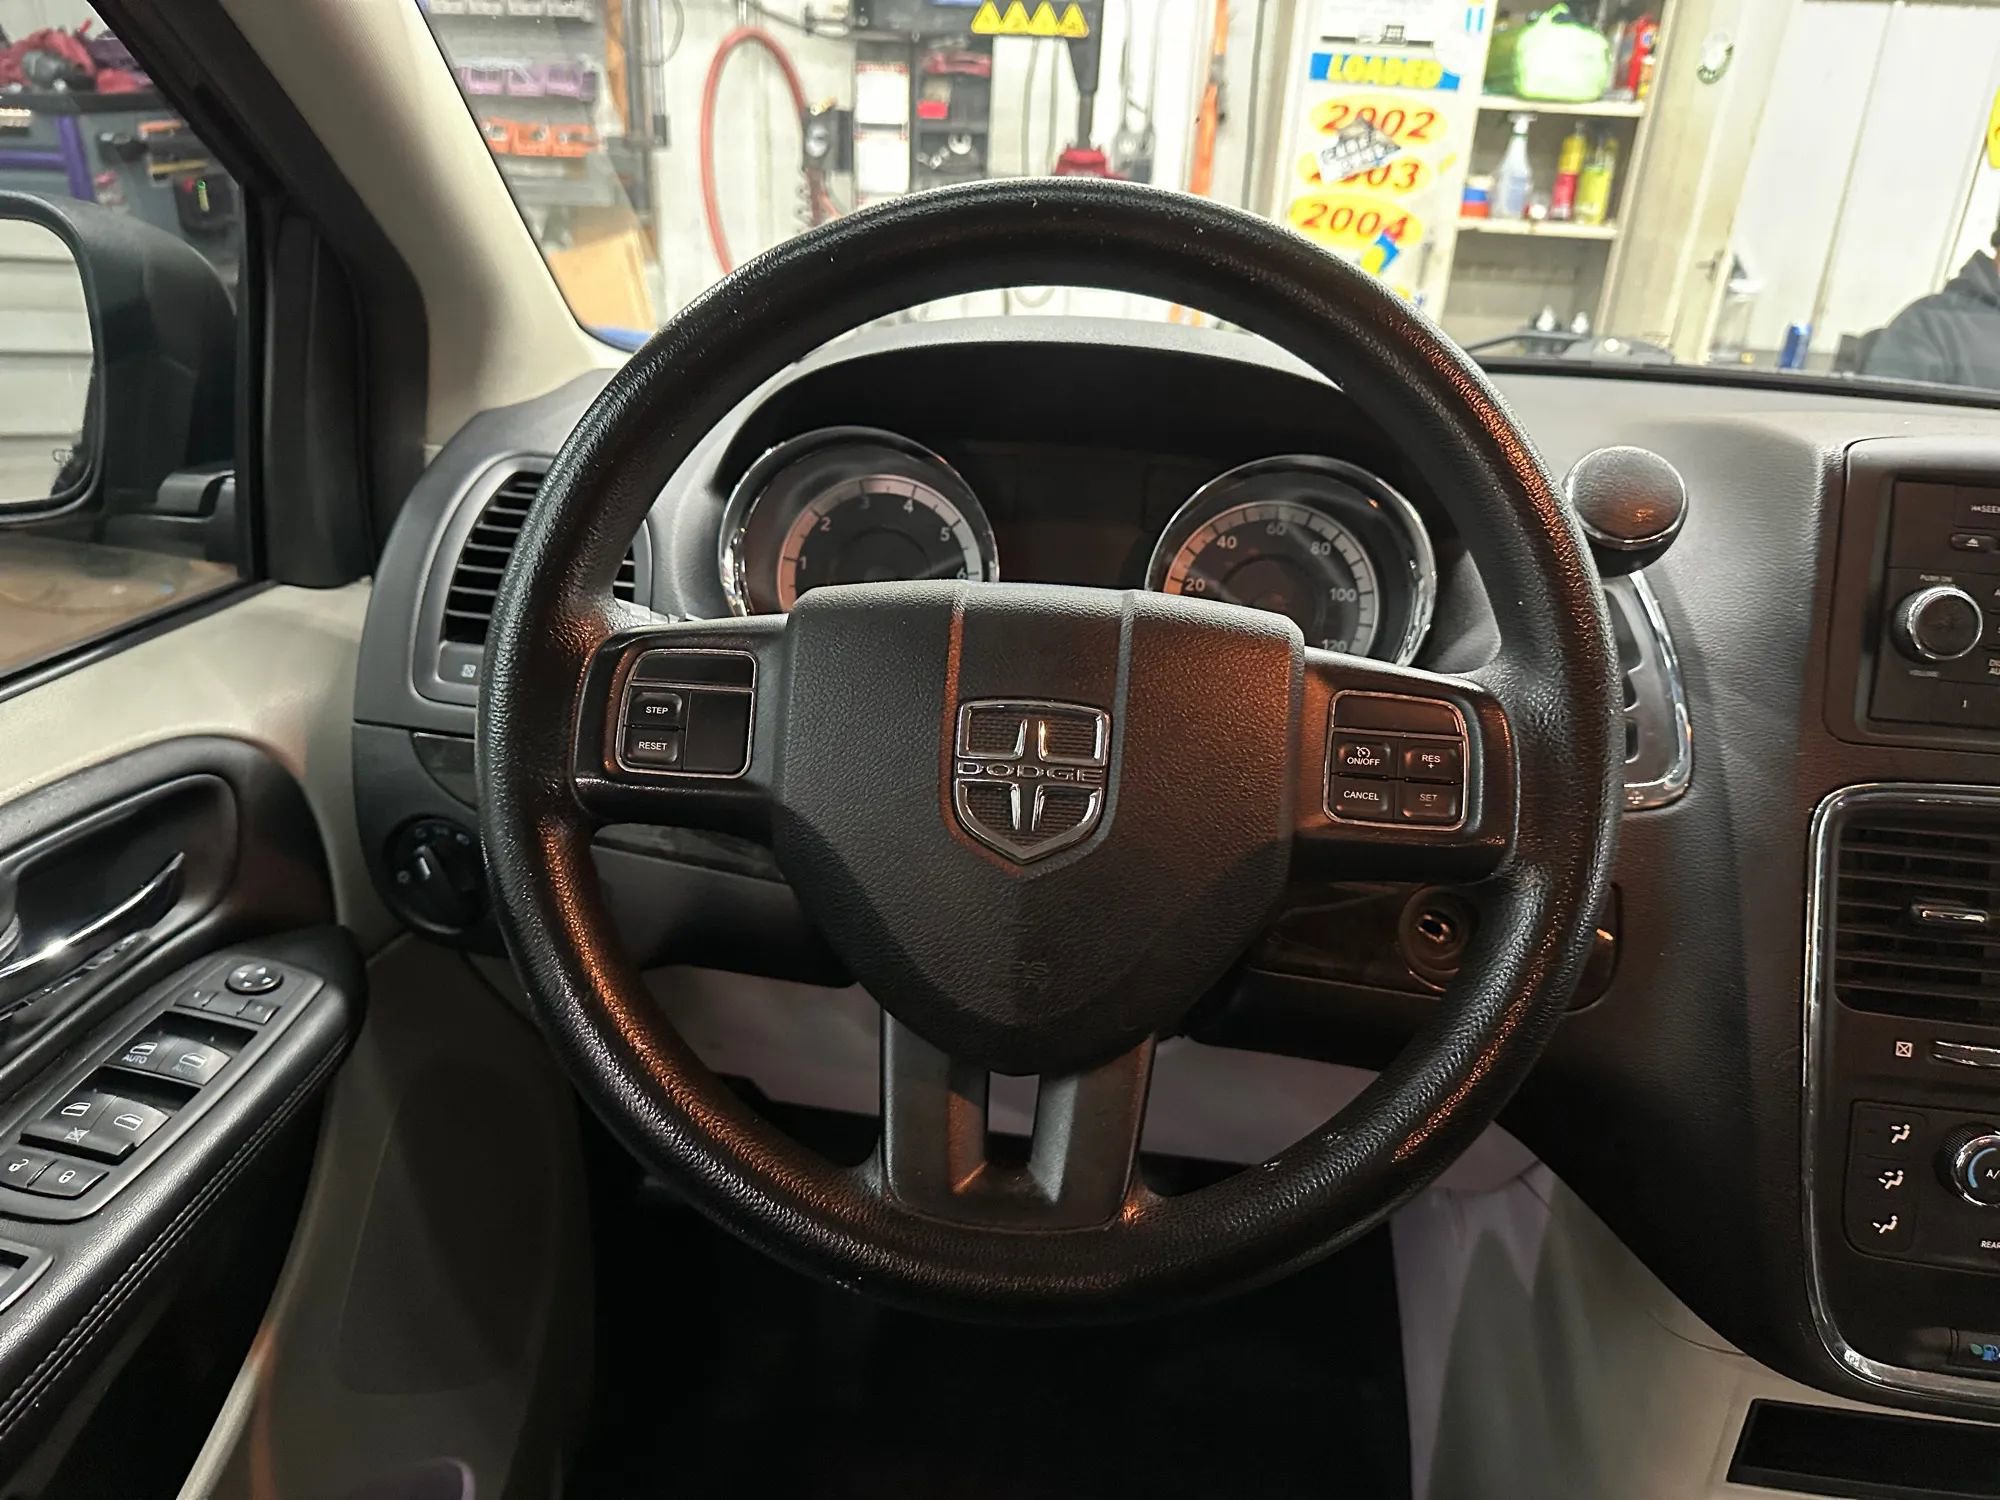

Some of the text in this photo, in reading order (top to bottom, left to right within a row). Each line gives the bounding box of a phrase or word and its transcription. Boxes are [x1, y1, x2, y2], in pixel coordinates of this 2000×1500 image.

[1326, 54, 1444, 89] LOADED
[1302, 203, 1409, 241] 2004
[903, 499, 914, 513] 4
[820, 517, 832, 532] 2
[1266, 522, 1287, 536] 60
[940, 527, 950, 542] 5
[1216, 535, 1237, 549] 40
[1310, 541, 1331, 556] 80
[800, 556, 807, 570] 1
[956, 568, 967, 580] 6
[1185, 578, 1206, 592] 20
[1329, 588, 1357, 603] 100
[1322, 638, 1348, 652] 120
[645, 706, 668, 714] STEP
[638, 741, 668, 751] RESET
[1346, 757, 1381, 766] ON/OFF
[1421, 755, 1441, 764] RES
[957, 762, 1103, 784] DODGE
[1343, 790, 1380, 801] CANCEL
[1419, 793, 1438, 802] SET
[121, 1054, 148, 1064] AUTO
